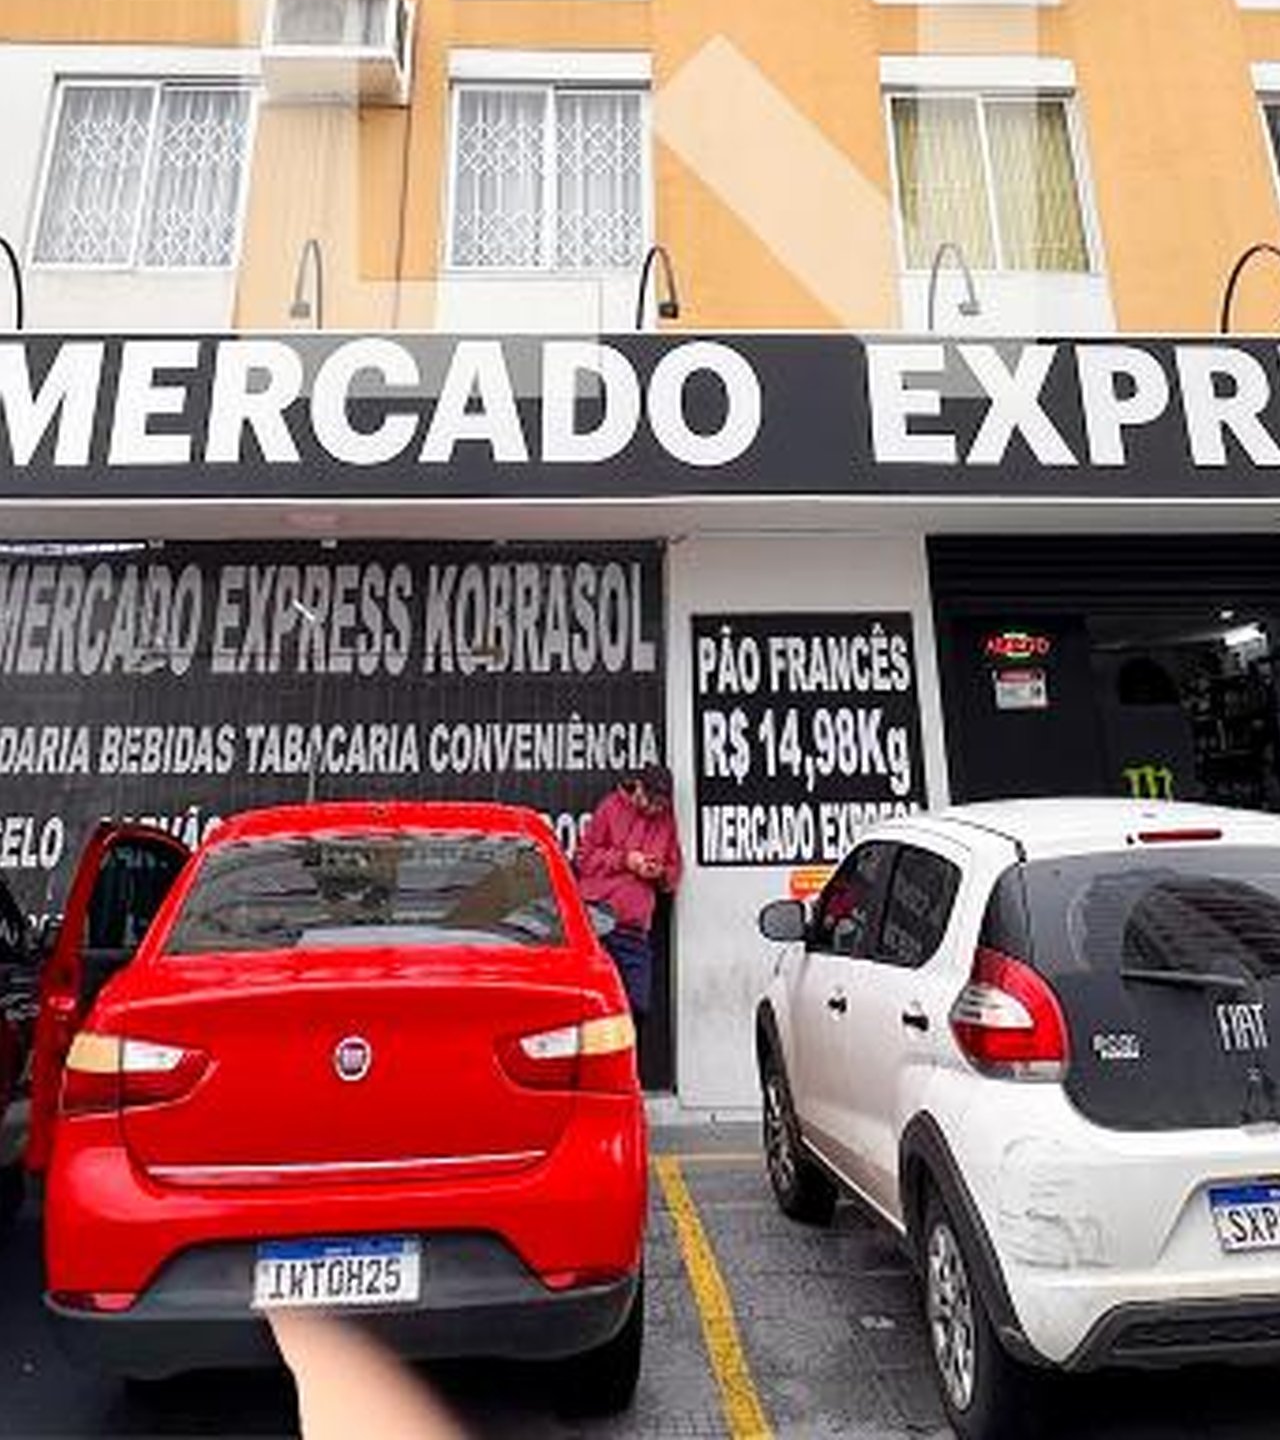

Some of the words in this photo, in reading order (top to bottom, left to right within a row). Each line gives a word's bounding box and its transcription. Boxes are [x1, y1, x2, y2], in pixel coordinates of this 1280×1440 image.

[211, 563, 413, 675] EXPRESS
[423, 562, 656, 674] KOBRASOL
[698, 625, 762, 694] PÃO
[768, 622, 911, 692] FRANCÊS
[99, 724, 236, 775] BEBIDAS
[245, 724, 420, 774] TABACARIA
[429, 711, 659, 773] CONVENIÊNCIA
[702, 707, 751, 785] R$
[758, 707, 911, 796] 14,98Kg
[701, 802, 815, 862] MERCADO
[1217, 1004, 1268, 1051] FIAT
